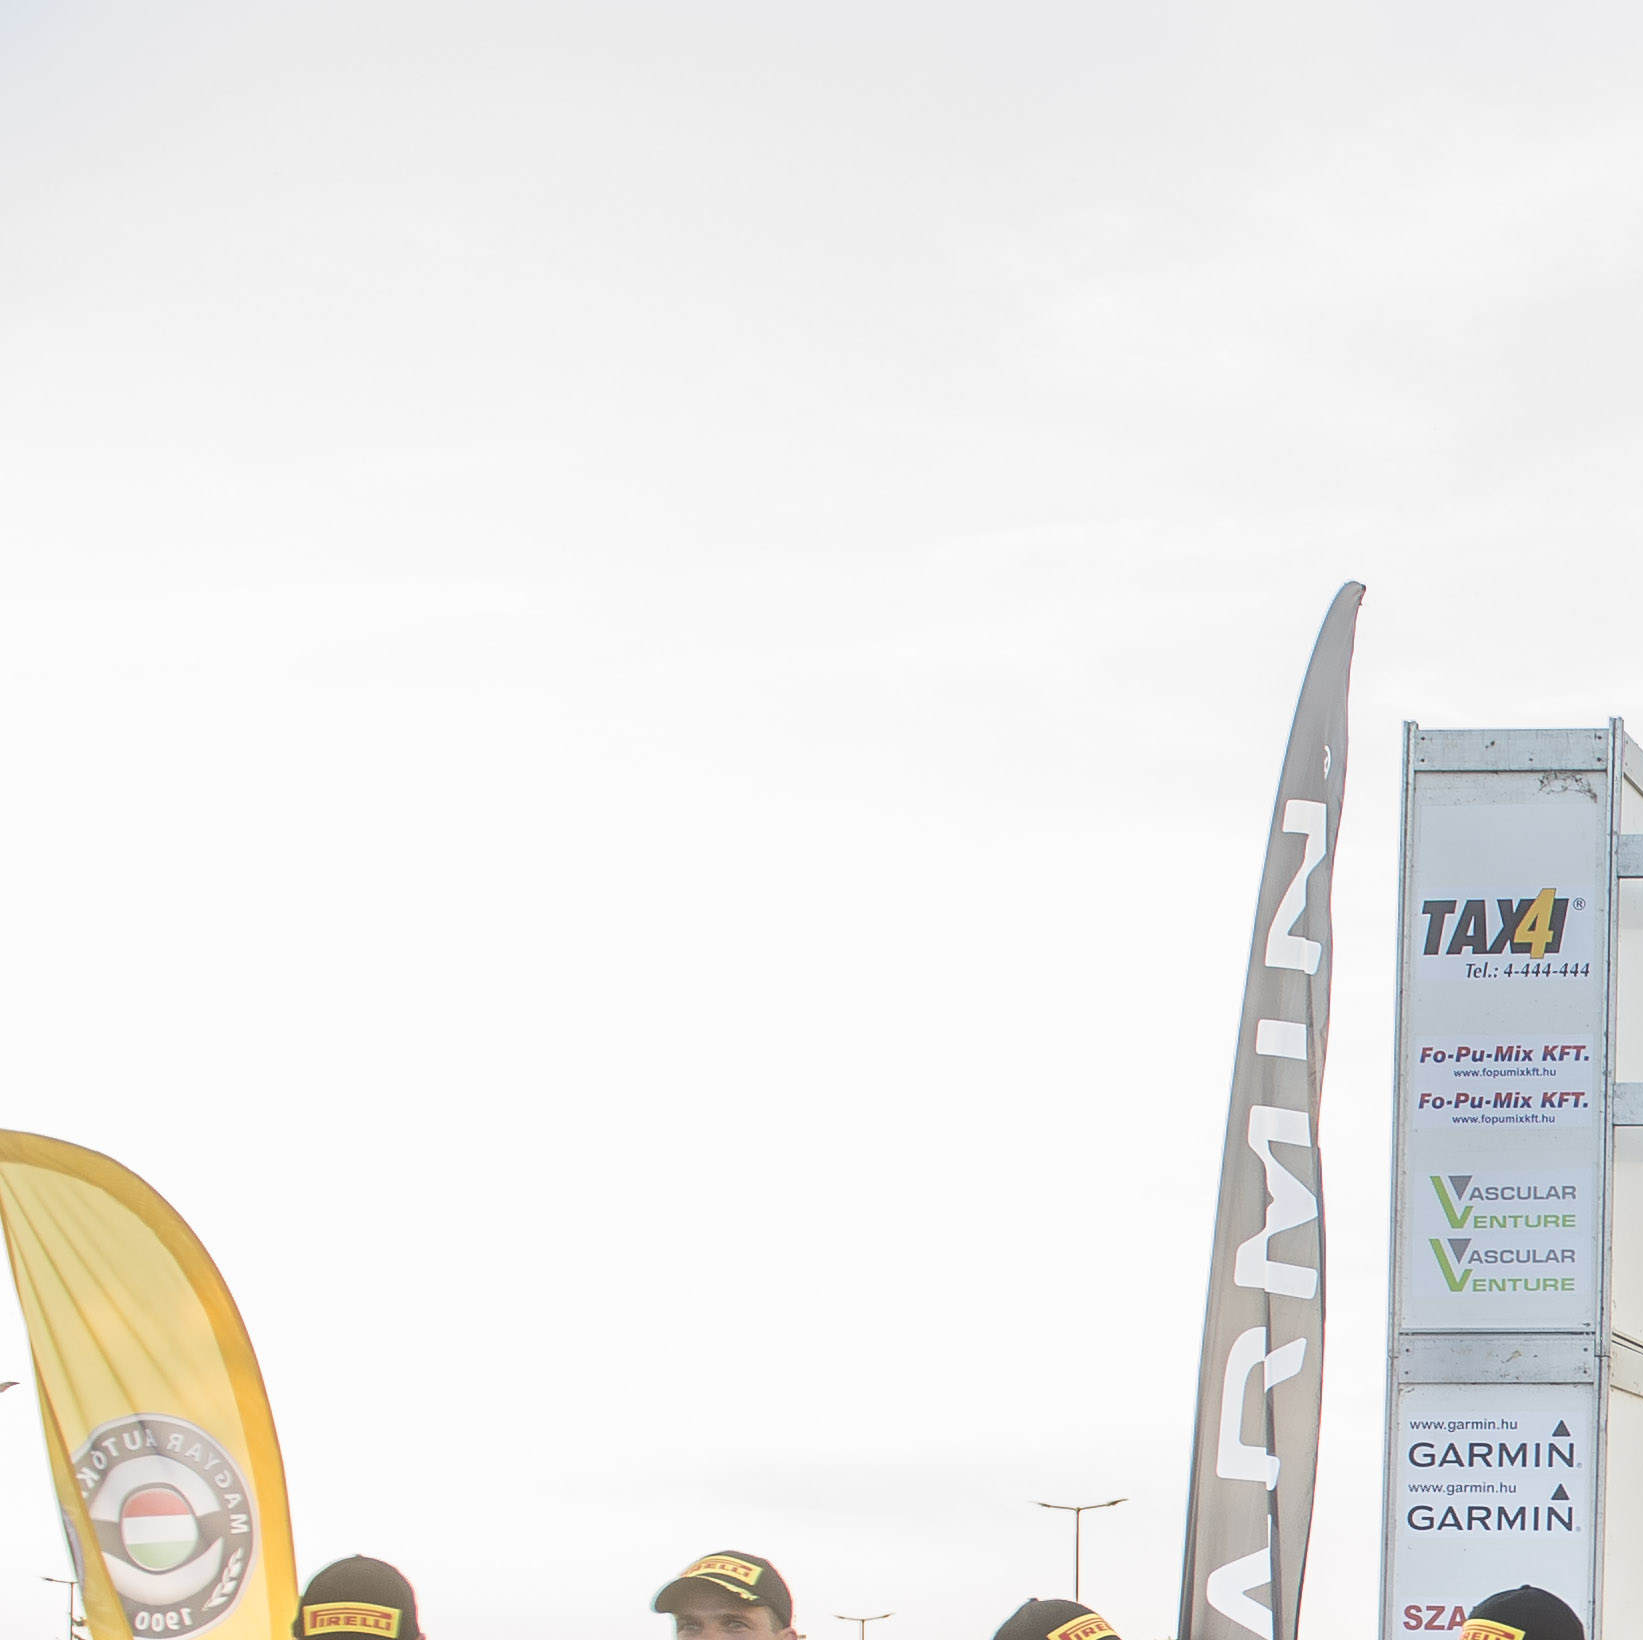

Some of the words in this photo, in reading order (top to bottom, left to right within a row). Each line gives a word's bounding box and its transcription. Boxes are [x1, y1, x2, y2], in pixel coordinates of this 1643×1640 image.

[1465, 962, 1499, 979] Tel.:
[1502, 962, 1591, 979] 4-444-444
[1419, 1045, 1535, 1065] Fo-Pu-Mix
[1541, 1045, 1591, 1063] KFT.
[1453, 1067, 1557, 1079] www.fopumixkft.hu
[1418, 1091, 1533, 1111] Fo-Pu-Mix
[1540, 1091, 1590, 1109] KFT.
[1451, 1113, 1556, 1126] www.fopumixkft.hu
[1409, 1418, 1518, 1433] www.garmin.hu
[1408, 1442, 1575, 1468] GARMIN
[1408, 1481, 1517, 1497] www.garmin.hu
[1407, 1505, 1574, 1532] GARMIN
[309, 1607, 393, 1632] PIRELLI
